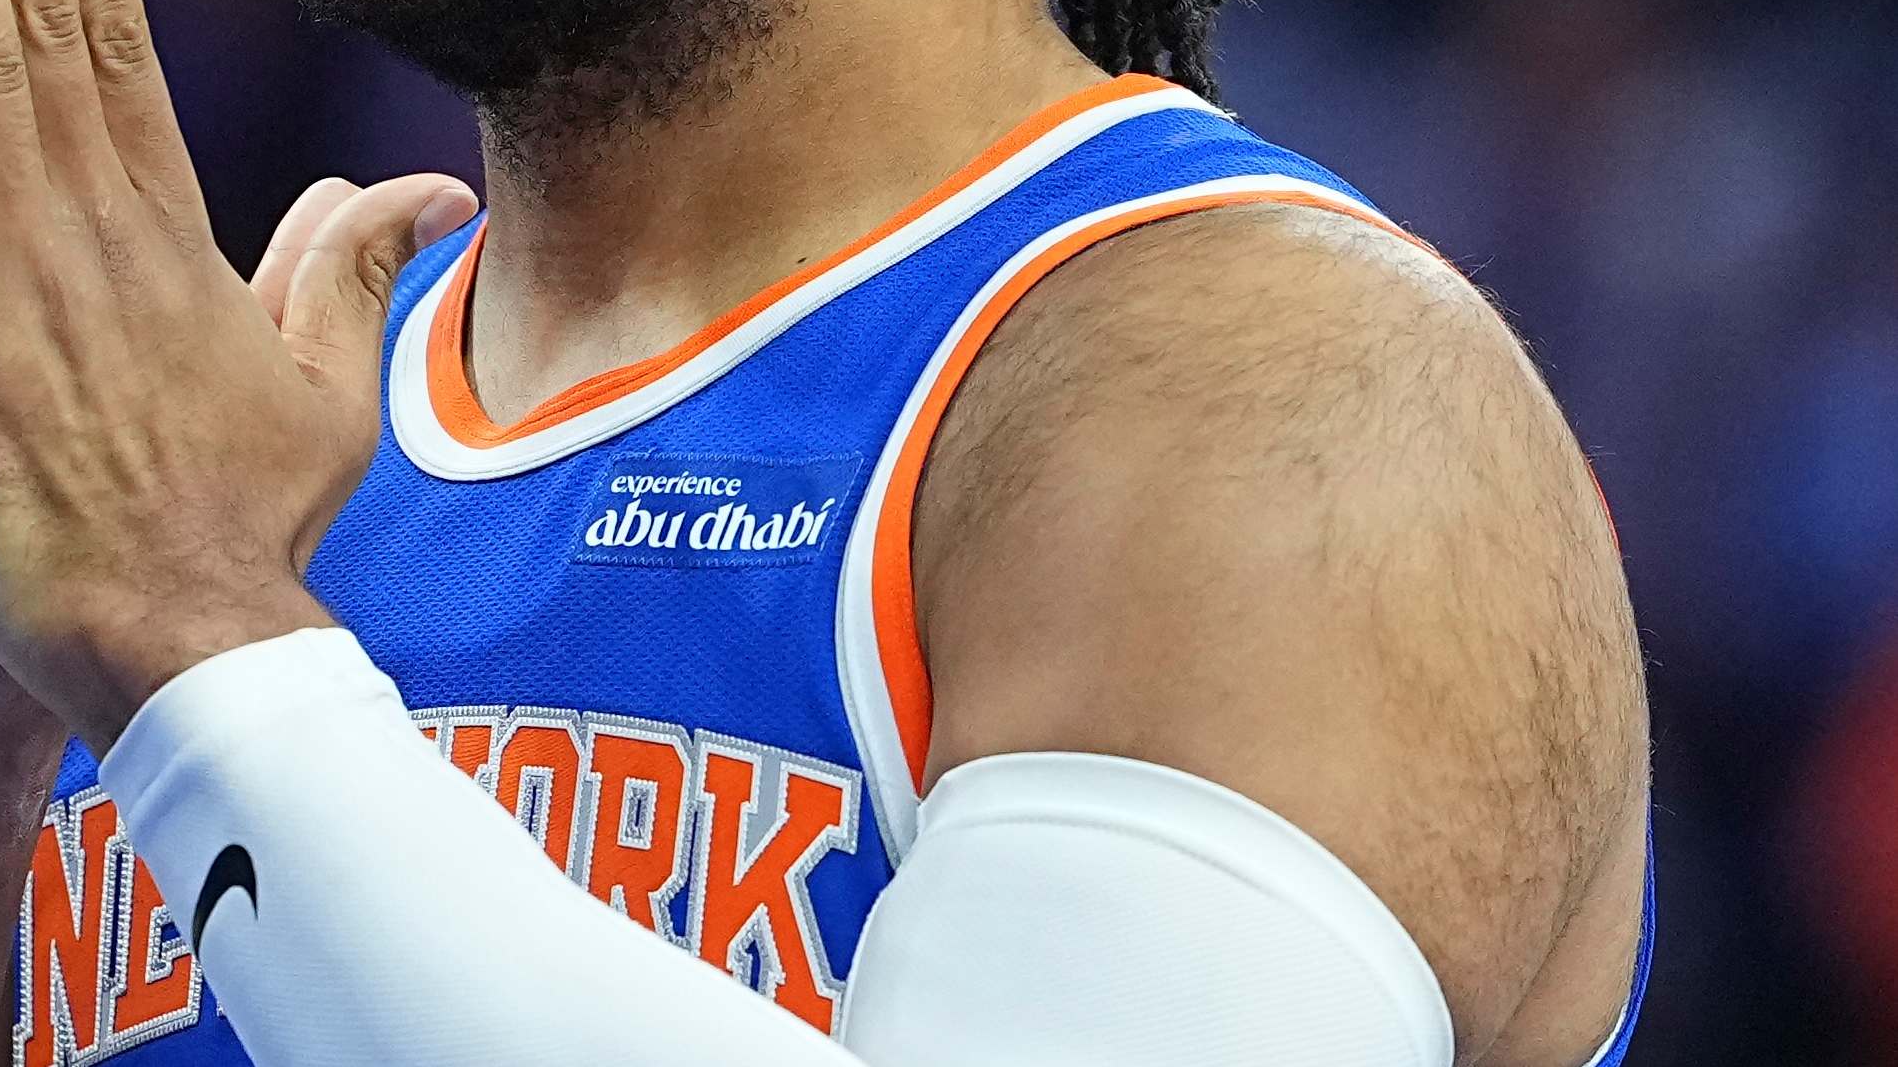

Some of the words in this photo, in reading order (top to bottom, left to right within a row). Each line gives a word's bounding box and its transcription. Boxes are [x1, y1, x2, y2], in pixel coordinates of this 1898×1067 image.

[610, 471, 742, 498] experience
[585, 498, 686, 549] abu
[13, 784, 202, 1067] NE
